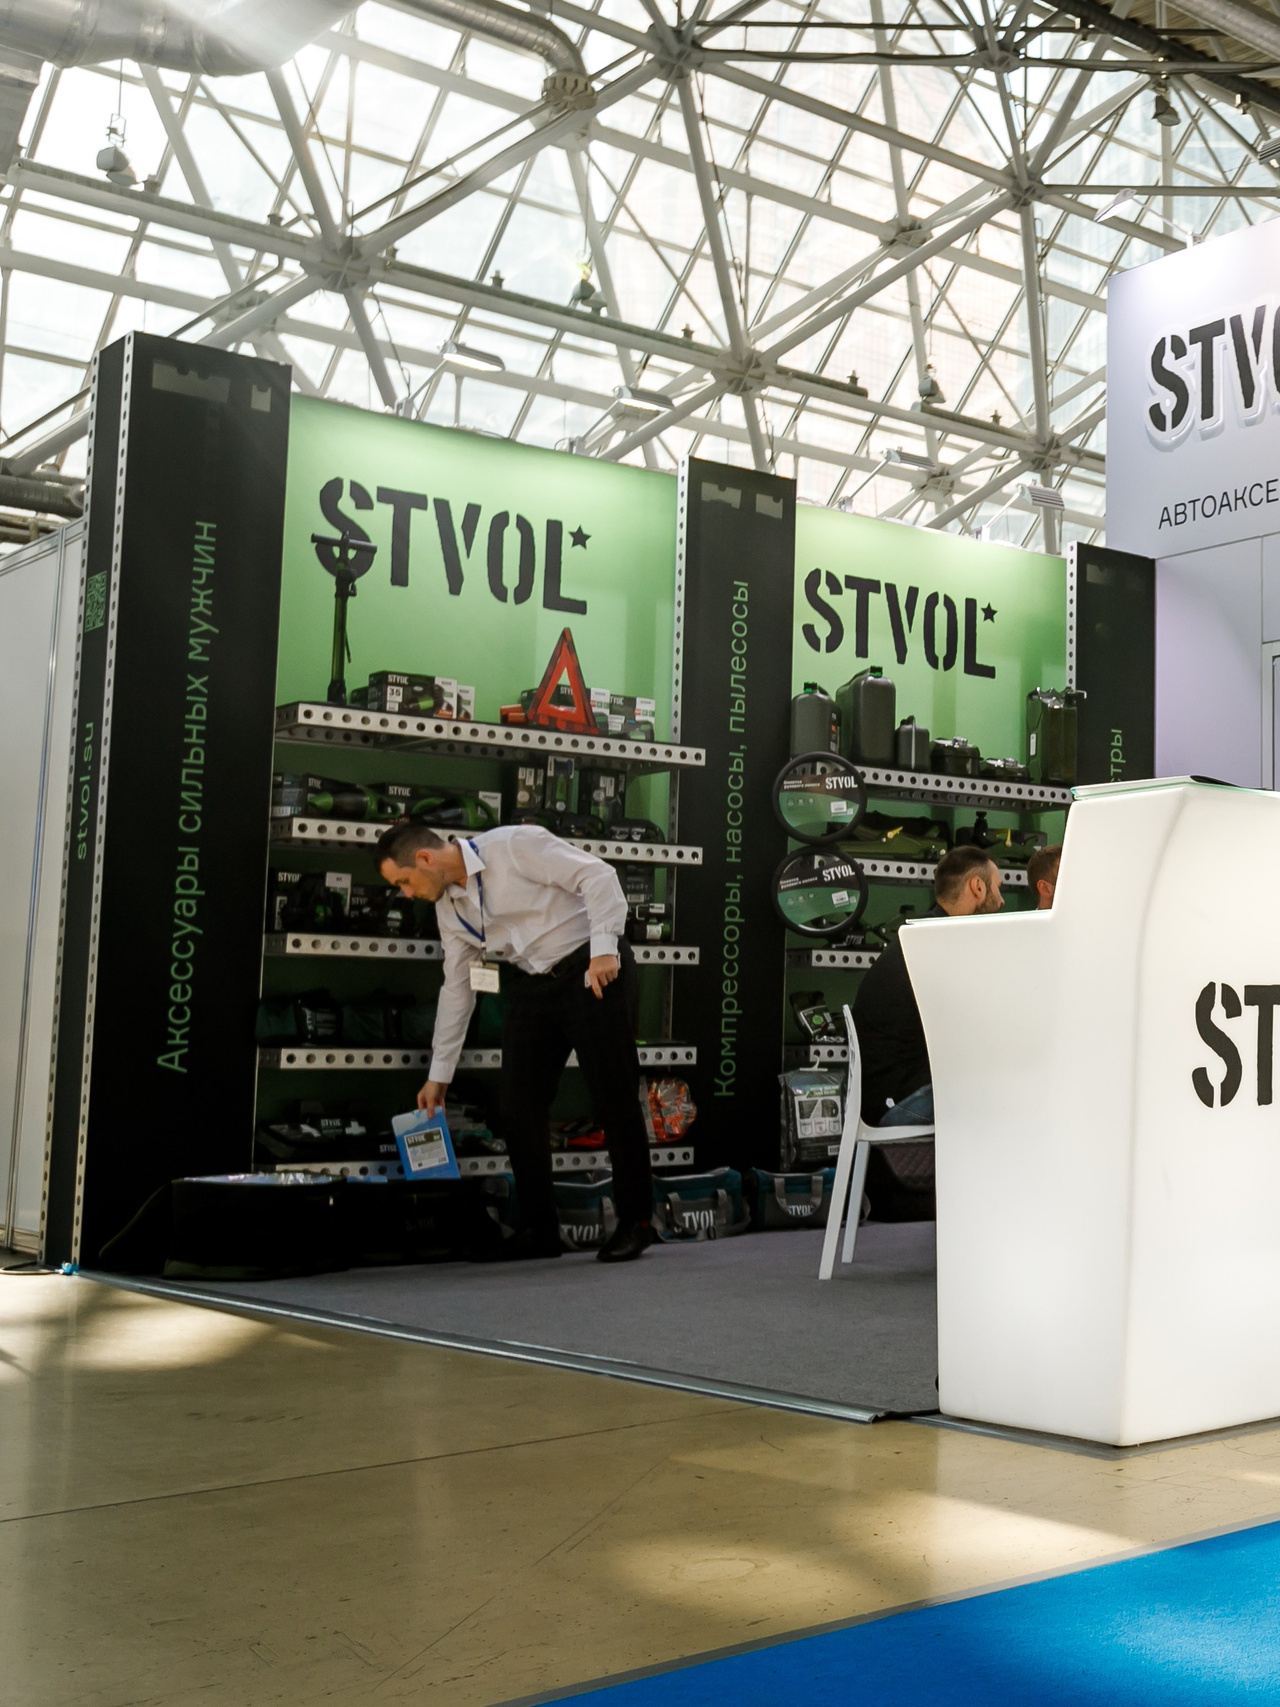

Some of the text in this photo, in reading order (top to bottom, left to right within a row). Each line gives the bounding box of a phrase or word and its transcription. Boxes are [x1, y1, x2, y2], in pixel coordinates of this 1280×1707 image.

[313, 477, 588, 616] STVOL
[802, 568, 996, 679] STVOL
[76, 720, 95, 861] stvol.su
[156, 519, 220, 1074] Аксессуары сильных мужчин
[714, 580, 749, 1097] Компрессоры, насосы, пылесосы
[825, 775, 858, 790] STVOL
[822, 864, 855, 882] STVOL
